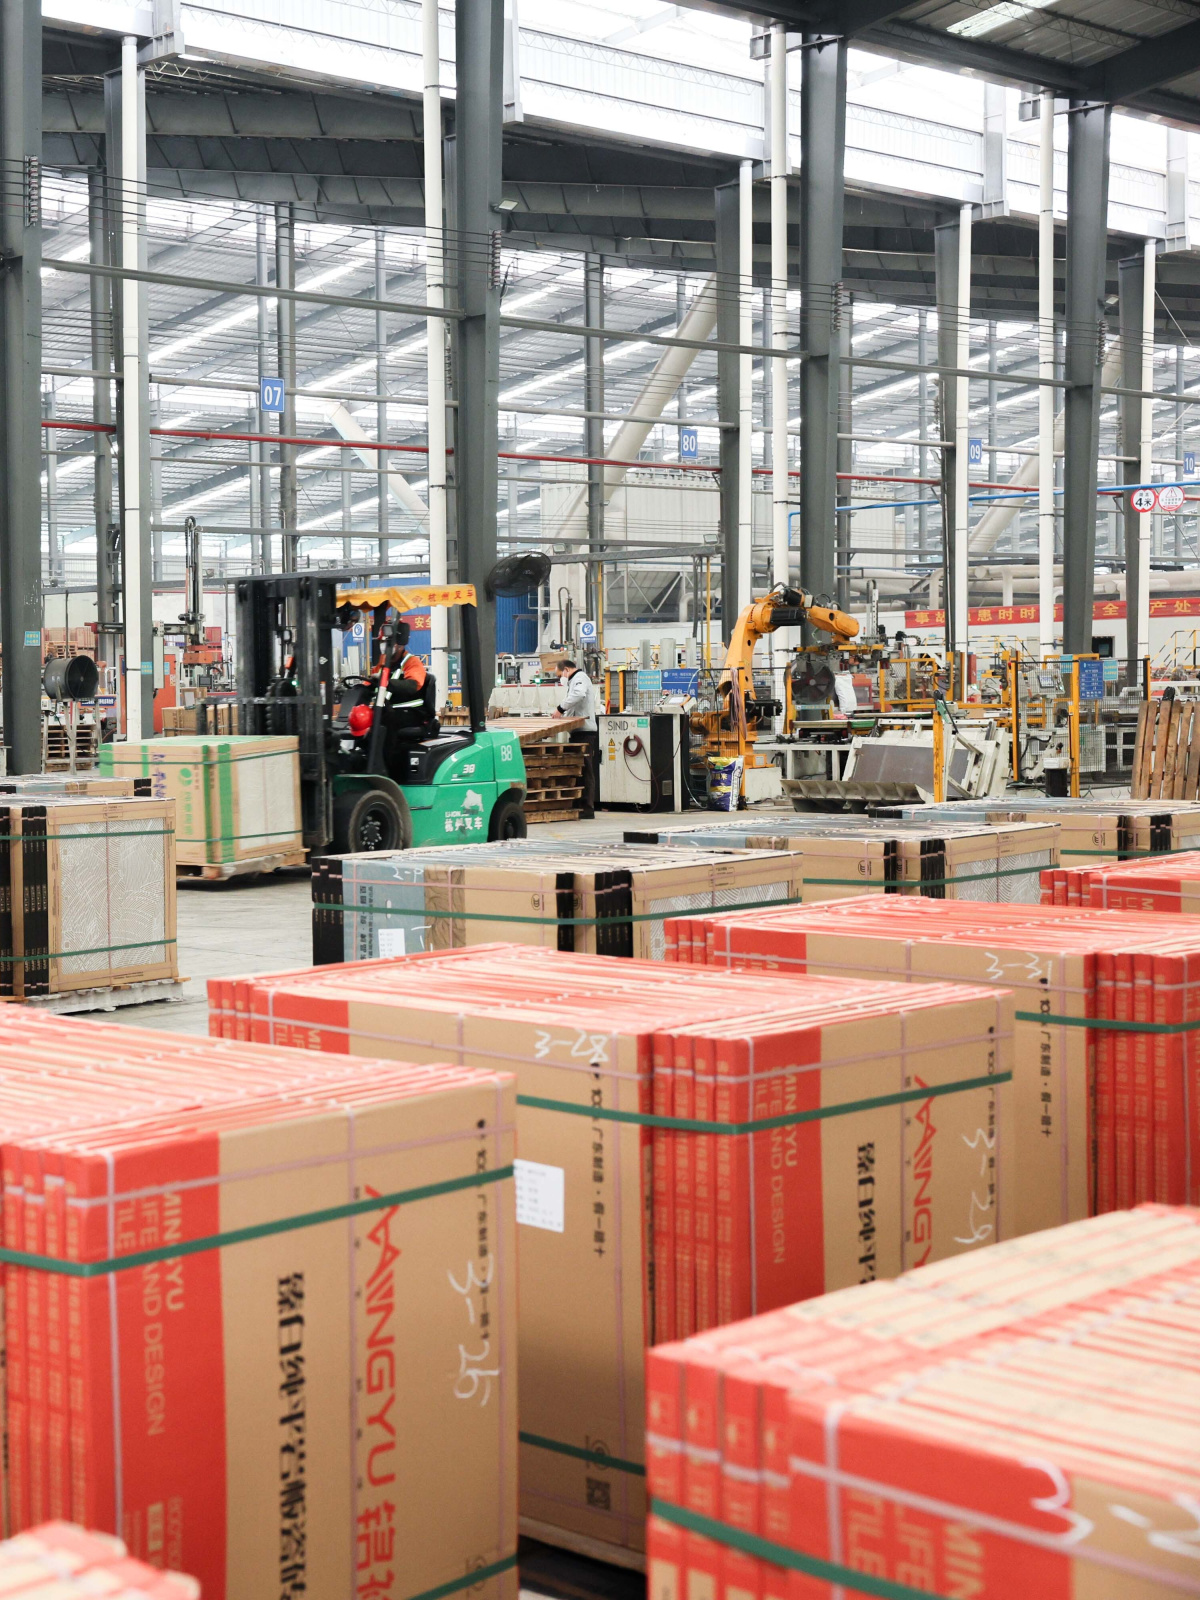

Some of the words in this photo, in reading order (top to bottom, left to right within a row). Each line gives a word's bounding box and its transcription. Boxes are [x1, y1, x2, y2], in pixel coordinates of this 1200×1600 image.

[263, 385, 282, 407] 07
[970, 444, 981, 460] 09
[1185, 457, 1194, 466] 10
[462, 763, 476, 774] 38
[144, 1322, 166, 1436] DESIGN
